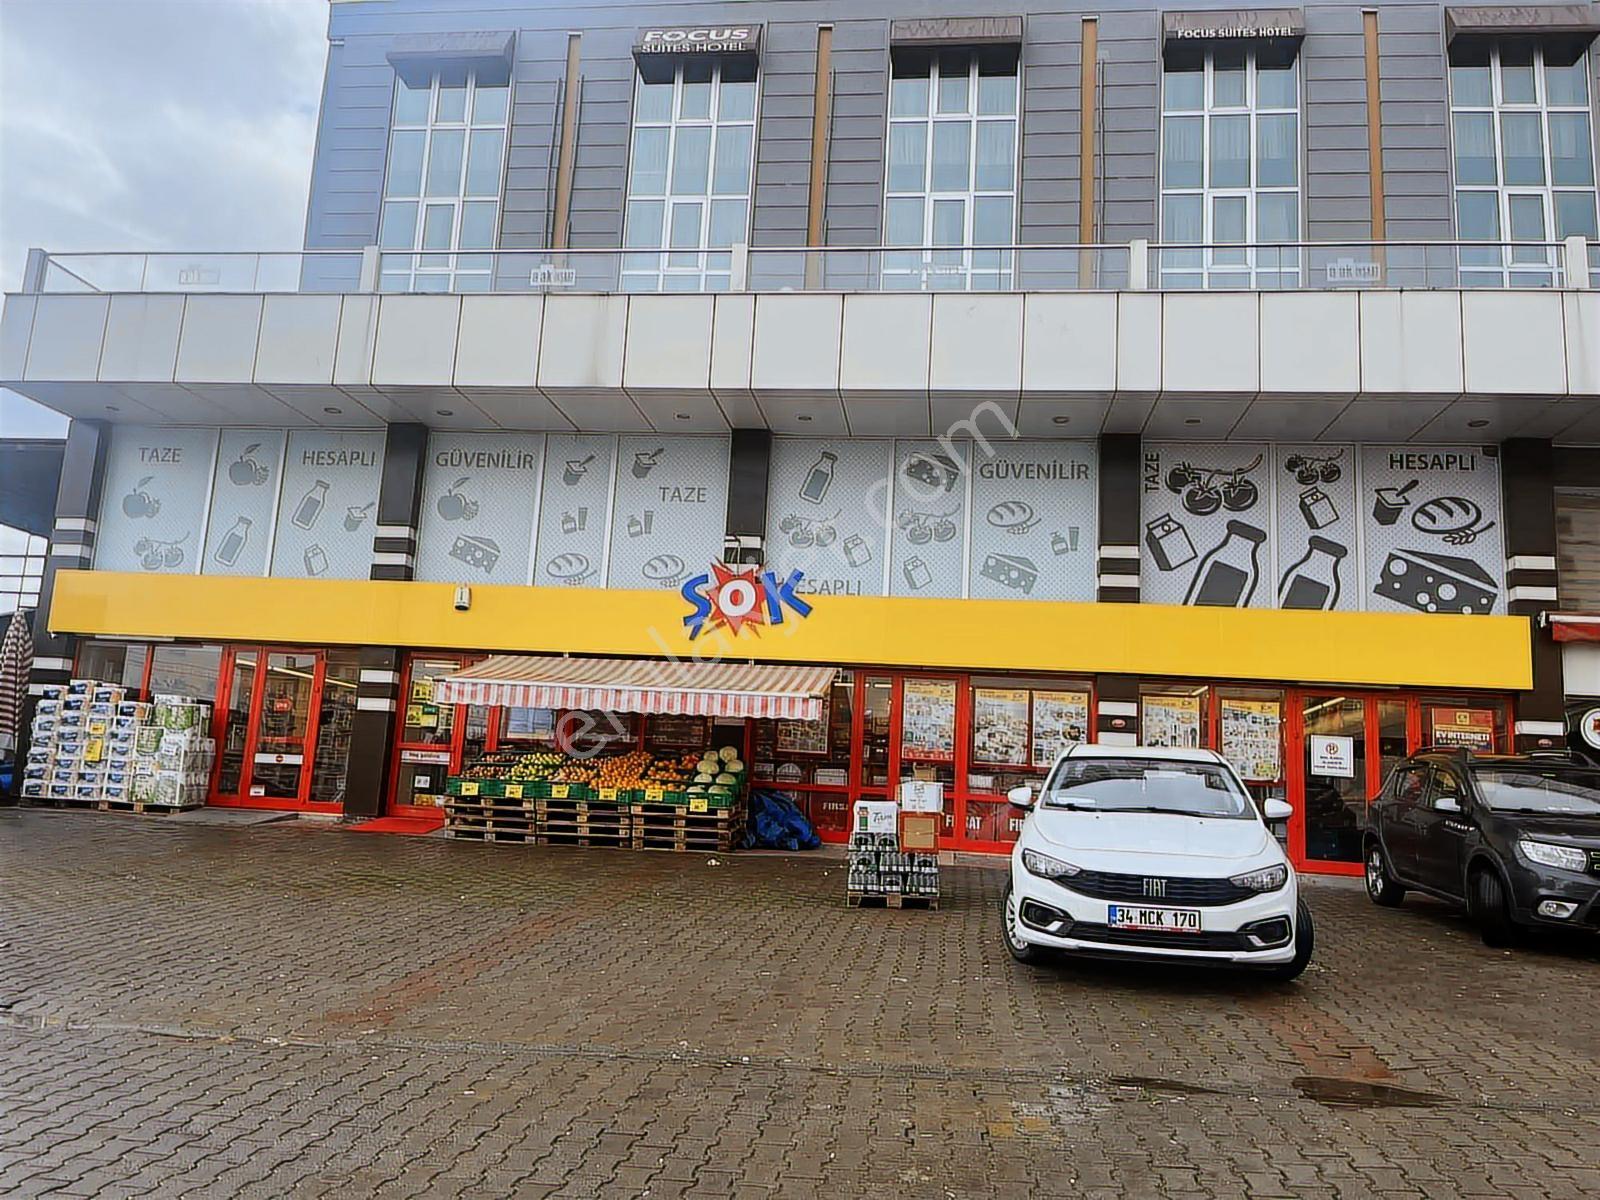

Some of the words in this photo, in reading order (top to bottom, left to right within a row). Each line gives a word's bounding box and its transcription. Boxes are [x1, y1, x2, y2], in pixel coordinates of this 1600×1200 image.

[643, 29, 749, 41] FOCUS
[1177, 28, 1215, 40] FOCUS
[1218, 27, 1257, 38] SUITES
[1259, 26, 1295, 37] HOTEL
[641, 43, 690, 53] SUITES
[695, 41, 745, 52] HOTEL
[139, 447, 183, 464] TAZE
[302, 449, 376, 467] HESAPLI
[436, 448, 534, 469] GÜVENİLİR
[1389, 453, 1475, 471] HESAPLI
[979, 459, 1089, 481] GÜVENİLİR
[1144, 452, 1160, 493] TAZE
[659, 486, 707, 503] TAZE
[777, 577, 862, 596] ESAPLI
[681, 567, 813, 641] ŞOK
[823, 802, 848, 811] FIRS
[945, 814, 982, 830] FIAT
[1143, 878, 1168, 898] FIAT
[1117, 908, 1133, 923] 34
[1140, 910, 1164, 926] MCK
[1172, 912, 1197, 927] 170
